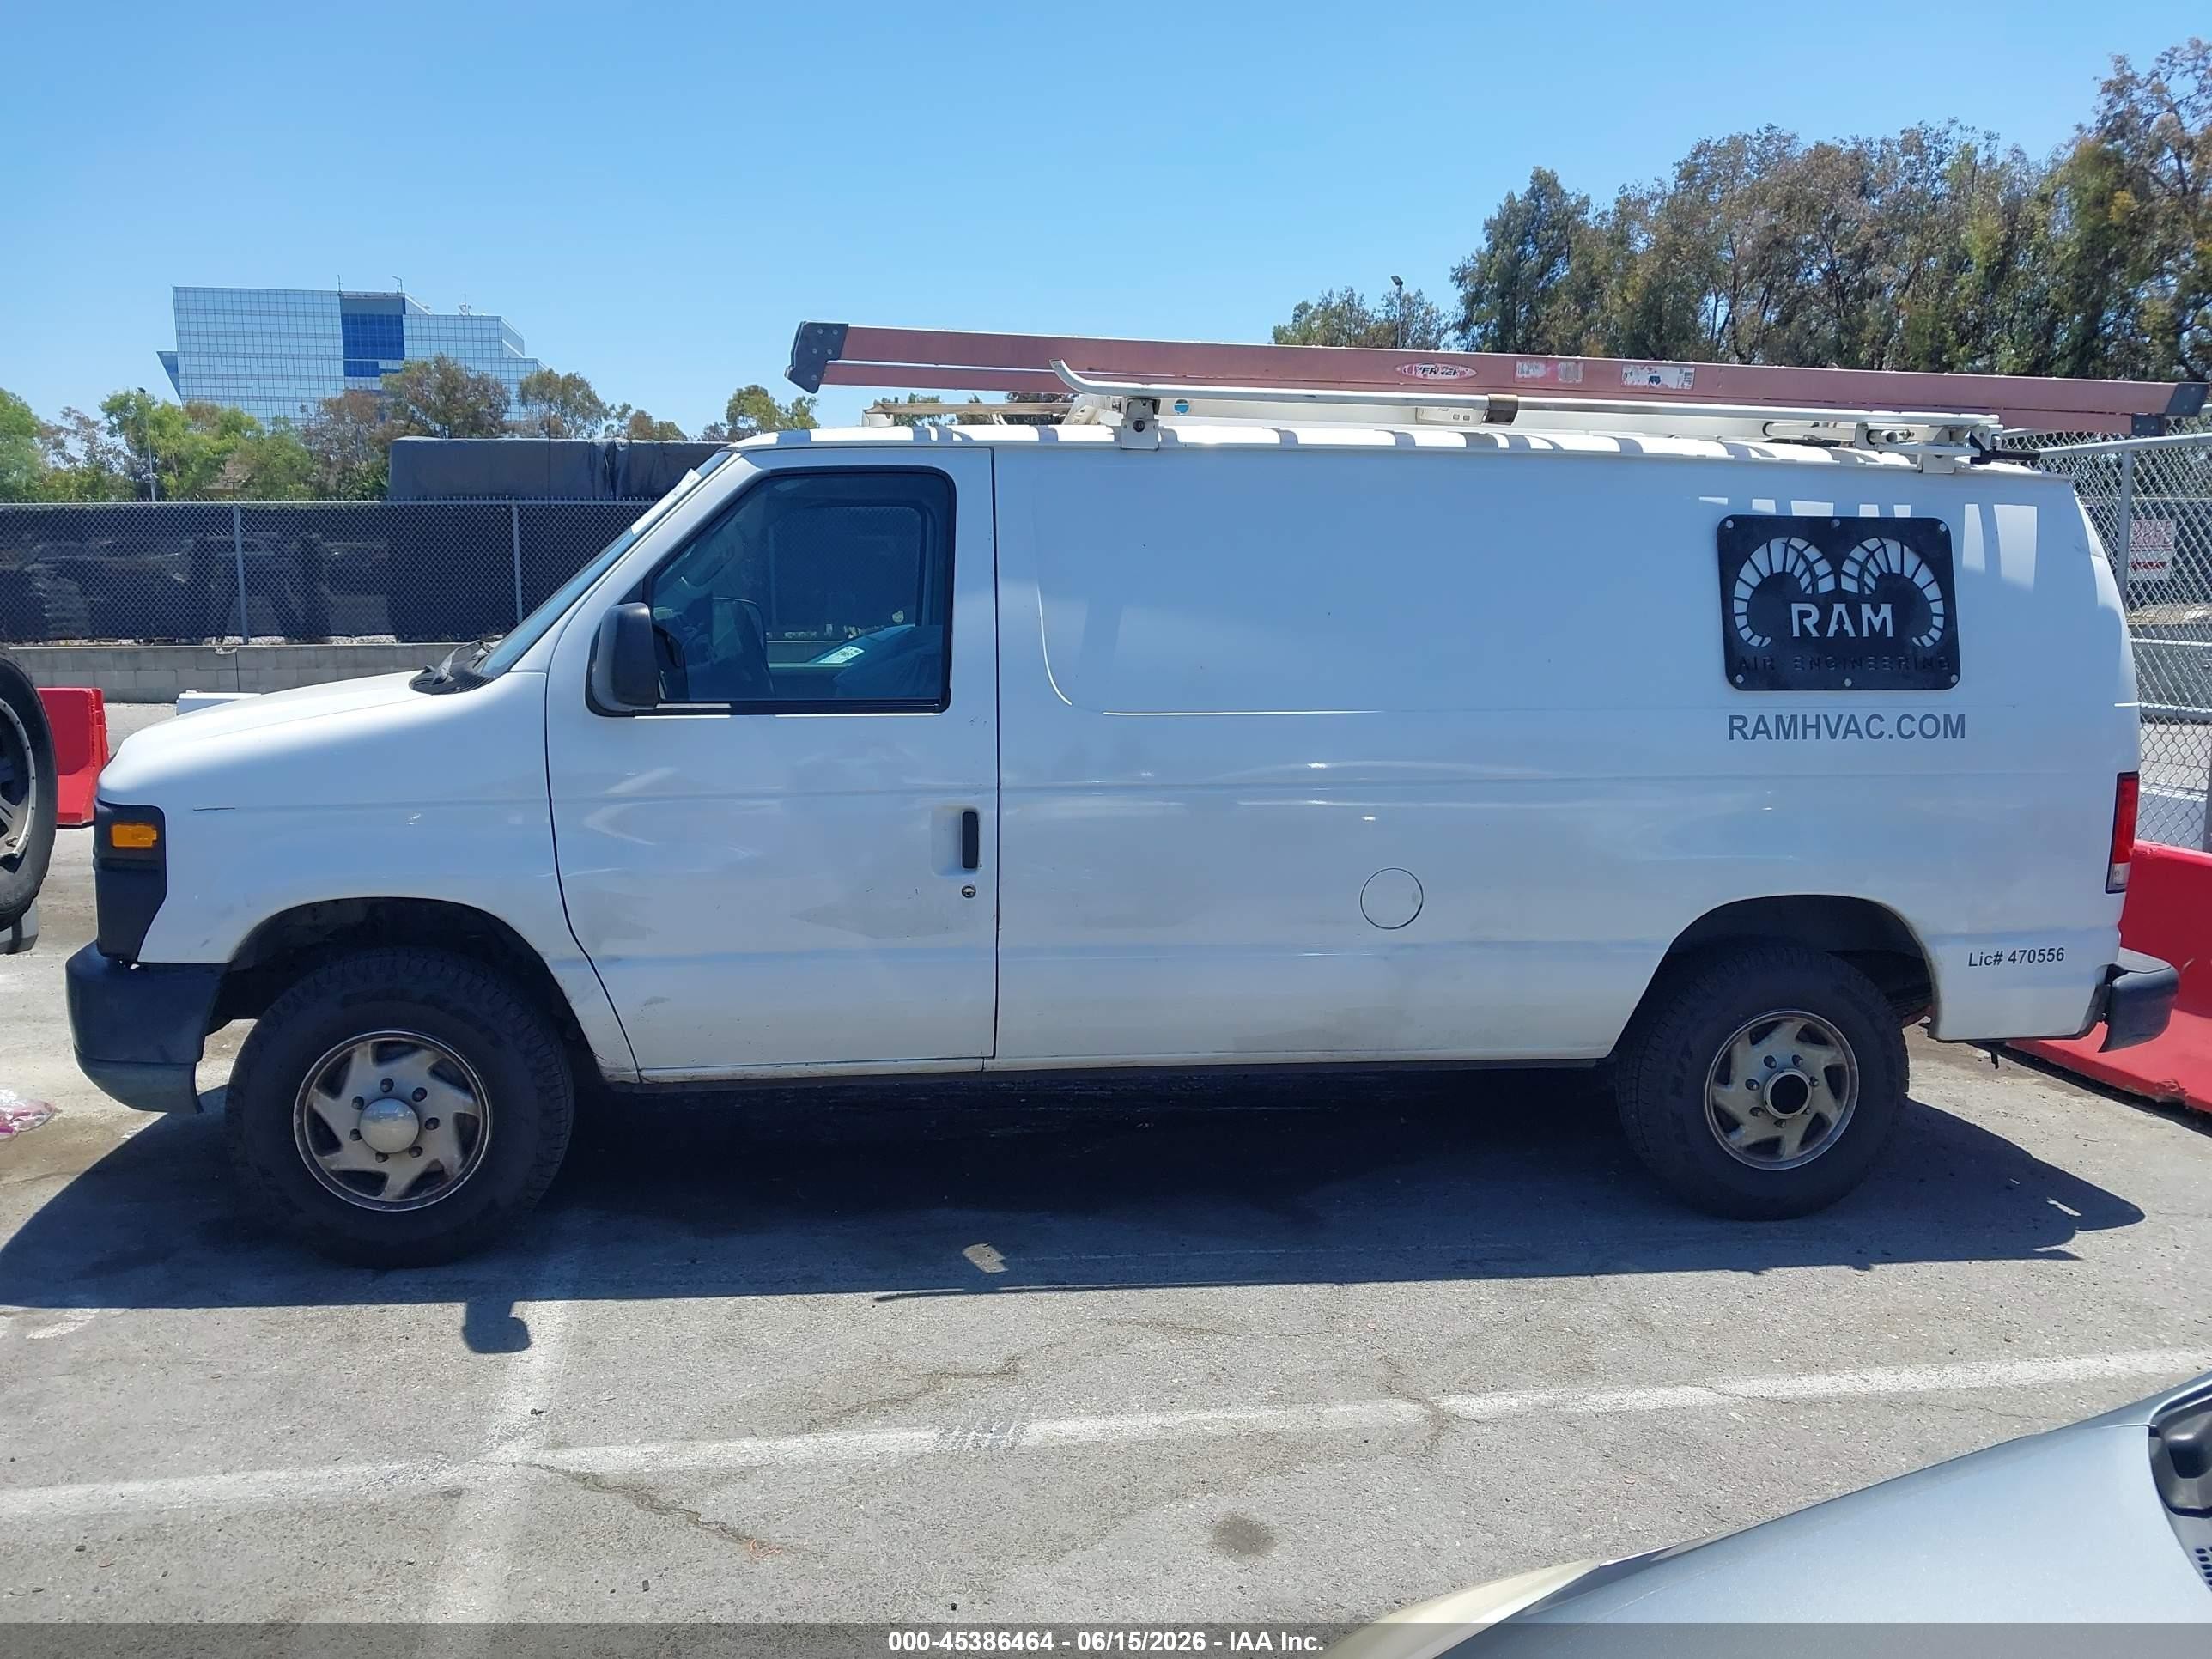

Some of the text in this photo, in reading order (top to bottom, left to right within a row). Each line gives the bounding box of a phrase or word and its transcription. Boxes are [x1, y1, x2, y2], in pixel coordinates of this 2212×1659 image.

[1791, 603, 1894, 637] RAM
[1736, 656, 1951, 671] AIR ENGINEERING
[1728, 714, 1966, 741] RAMHVAC.COM
[1968, 947, 2065, 967] Lic# 470556
